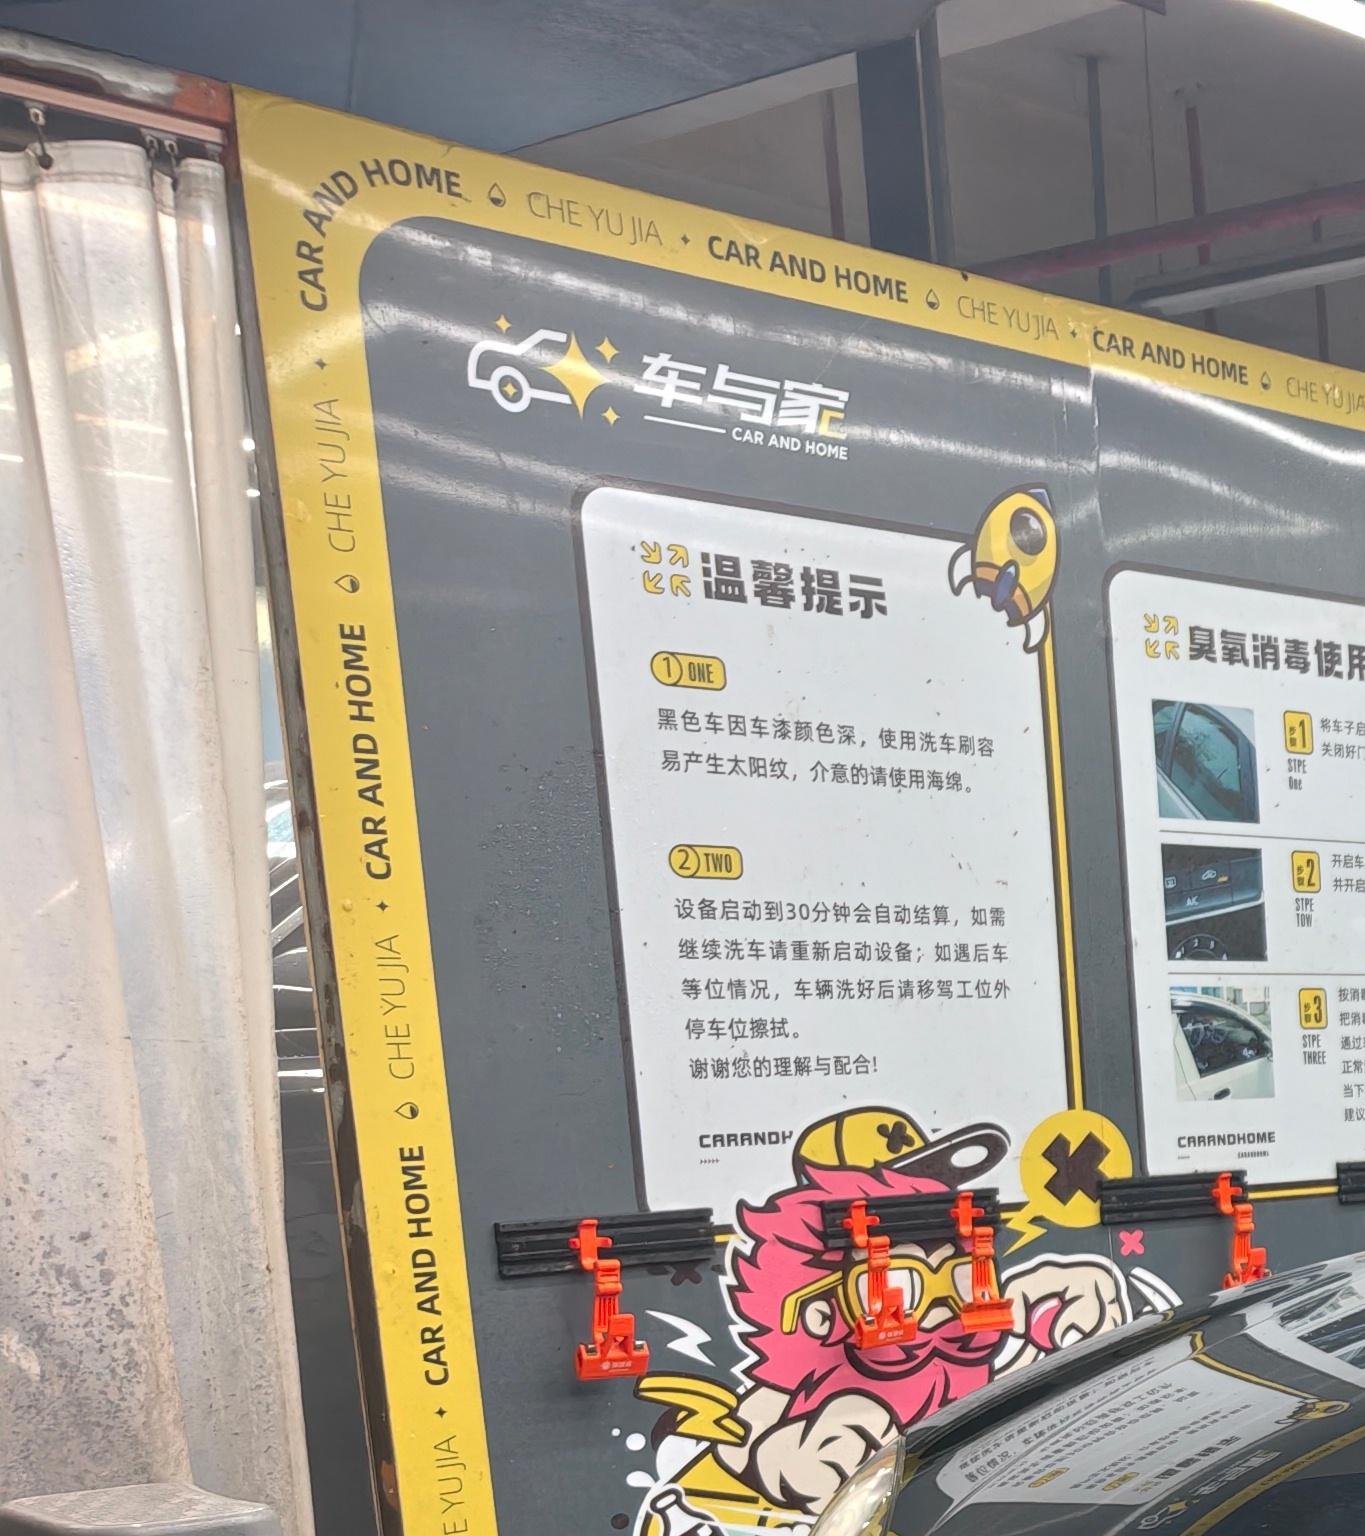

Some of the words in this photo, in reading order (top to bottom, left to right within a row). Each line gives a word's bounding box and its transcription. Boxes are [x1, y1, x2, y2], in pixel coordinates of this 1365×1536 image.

[360, 159, 462, 197] HOME
[304, 170, 358, 238] AND
[528, 192, 582, 226] CHE
[296, 239, 327, 311] CAR
[708, 235, 761, 269] CAR
[770, 255, 826, 283] AND
[835, 267, 909, 303] HOME
[957, 296, 999, 324] CHE
[1093, 330, 1135, 358] CAR
[1141, 341, 1185, 369] AND
[1192, 354, 1248, 386] HOME
[632, 353, 850, 440] 车与家
[732, 427, 764, 446] CAR
[768, 434, 801, 452] AND
[805, 440, 849, 460] HOME
[324, 492, 355, 553] CHE
[701, 552, 888, 619] 温馨提示
[339, 623, 375, 722] HOME
[688, 661, 713, 684] ONE
[657, 708, 995, 758] 黑色车因车漆颜色深，使用洗车刷容
[353, 733, 384, 808] AND
[661, 750, 972, 793] 易产生太阳纹，介意的请使用海绵。
[363, 816, 392, 880] CAR
[704, 851, 733, 874] TWO
[674, 898, 1006, 928] 设备启动到30分钟会自动结算，如需
[1295, 898, 1314, 912] STPE
[681, 977, 1010, 1001] 等位情况，车辆洗好后请移驾工位外
[386, 1023, 414, 1080] CHE
[685, 1017, 801, 1040] 停车位擦拭。
[1303, 1034, 1320, 1048] STPE
[1303, 1051, 1326, 1064] THREE
[1178, 1131, 1275, 1148] CARANDHOME
[399, 1146, 433, 1238] HOME
[412, 1248, 442, 1316] AND
[421, 1325, 449, 1386] CAR
